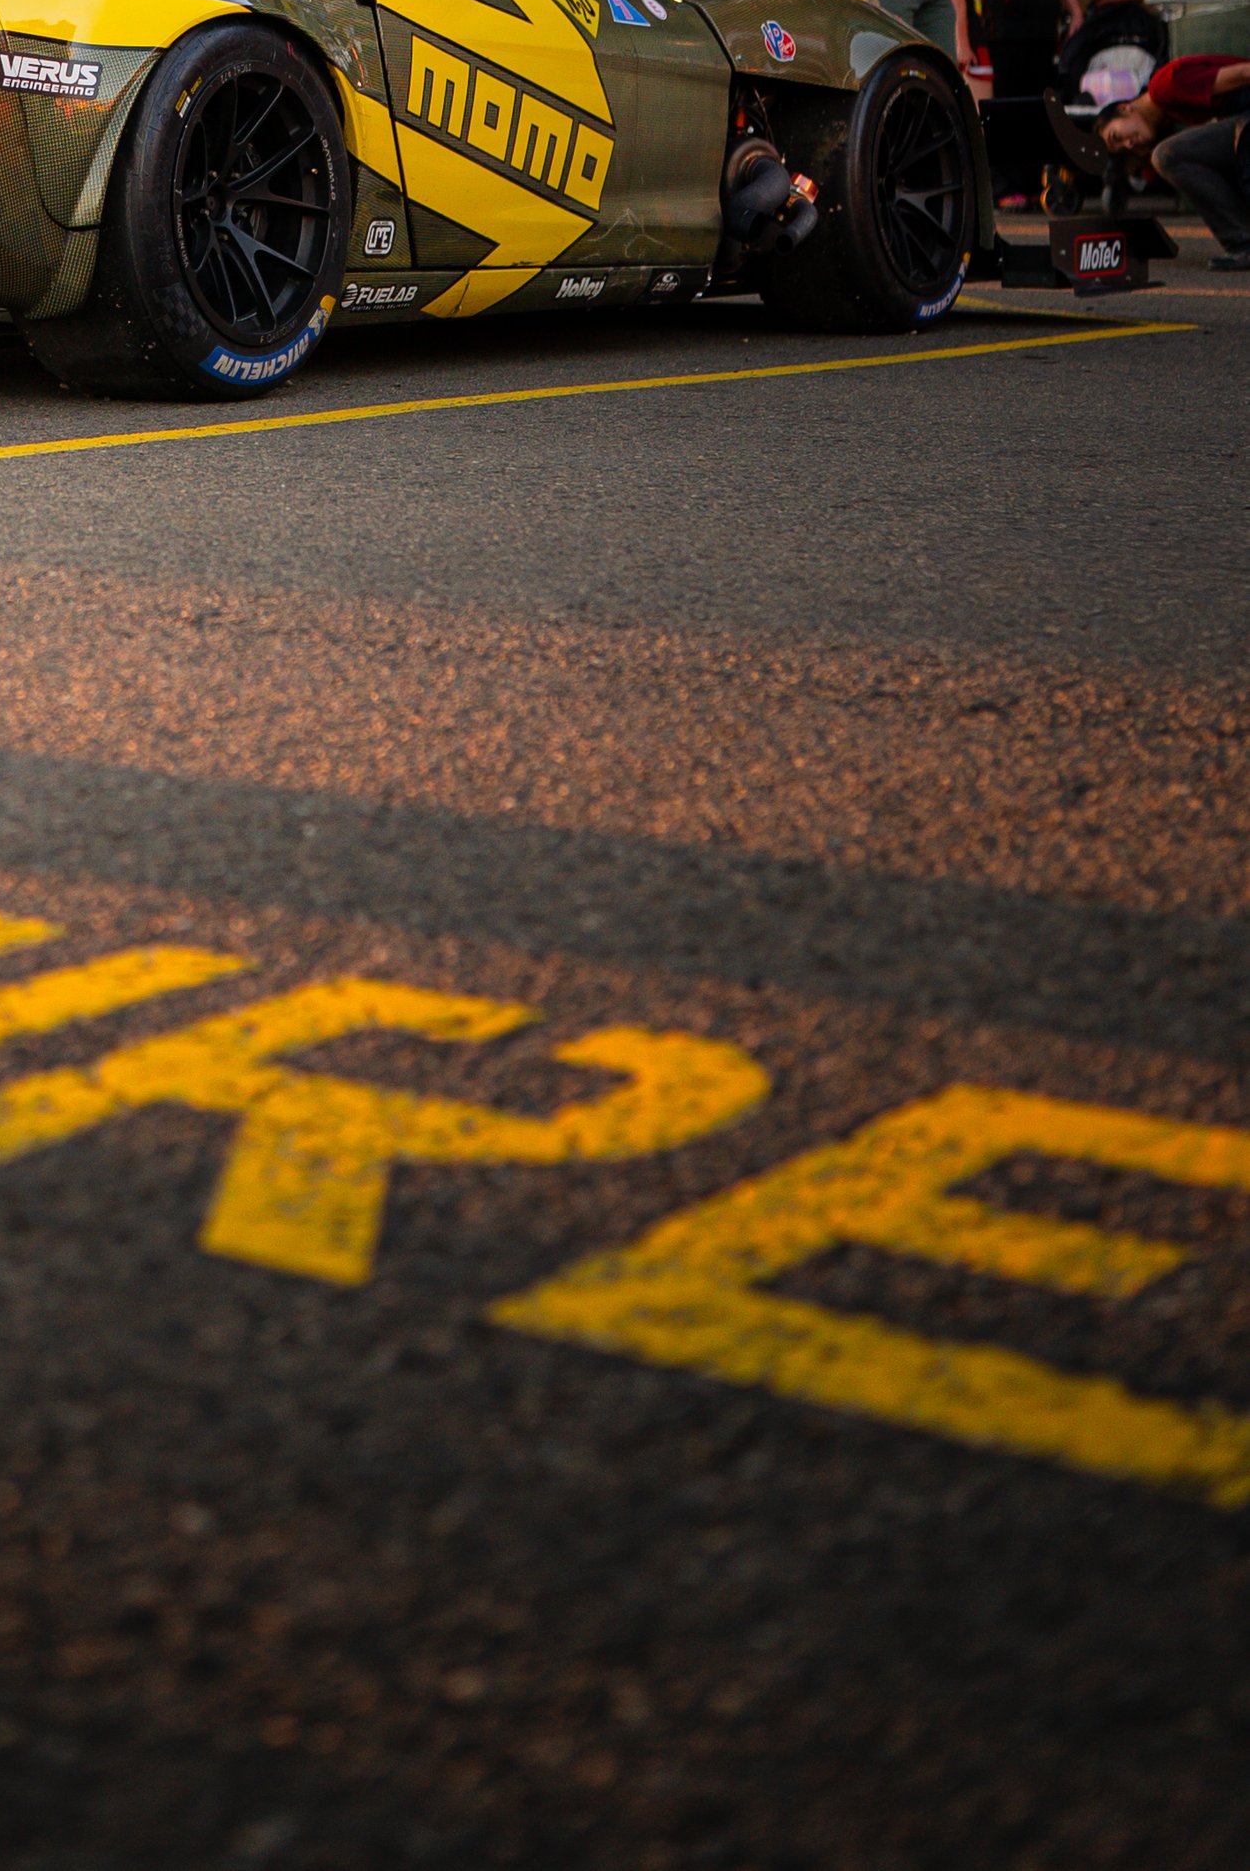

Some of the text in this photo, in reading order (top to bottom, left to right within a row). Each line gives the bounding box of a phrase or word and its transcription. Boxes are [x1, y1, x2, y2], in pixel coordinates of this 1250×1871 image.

[0, 53, 101, 87] VERUS
[2, 77, 96, 98] ENGINEERING
[1081, 240, 1122, 271] MoTeC
[356, 285, 418, 305] FUELAB
[555, 276, 607, 301] Holley
[212, 332, 310, 381] MICHELIN
